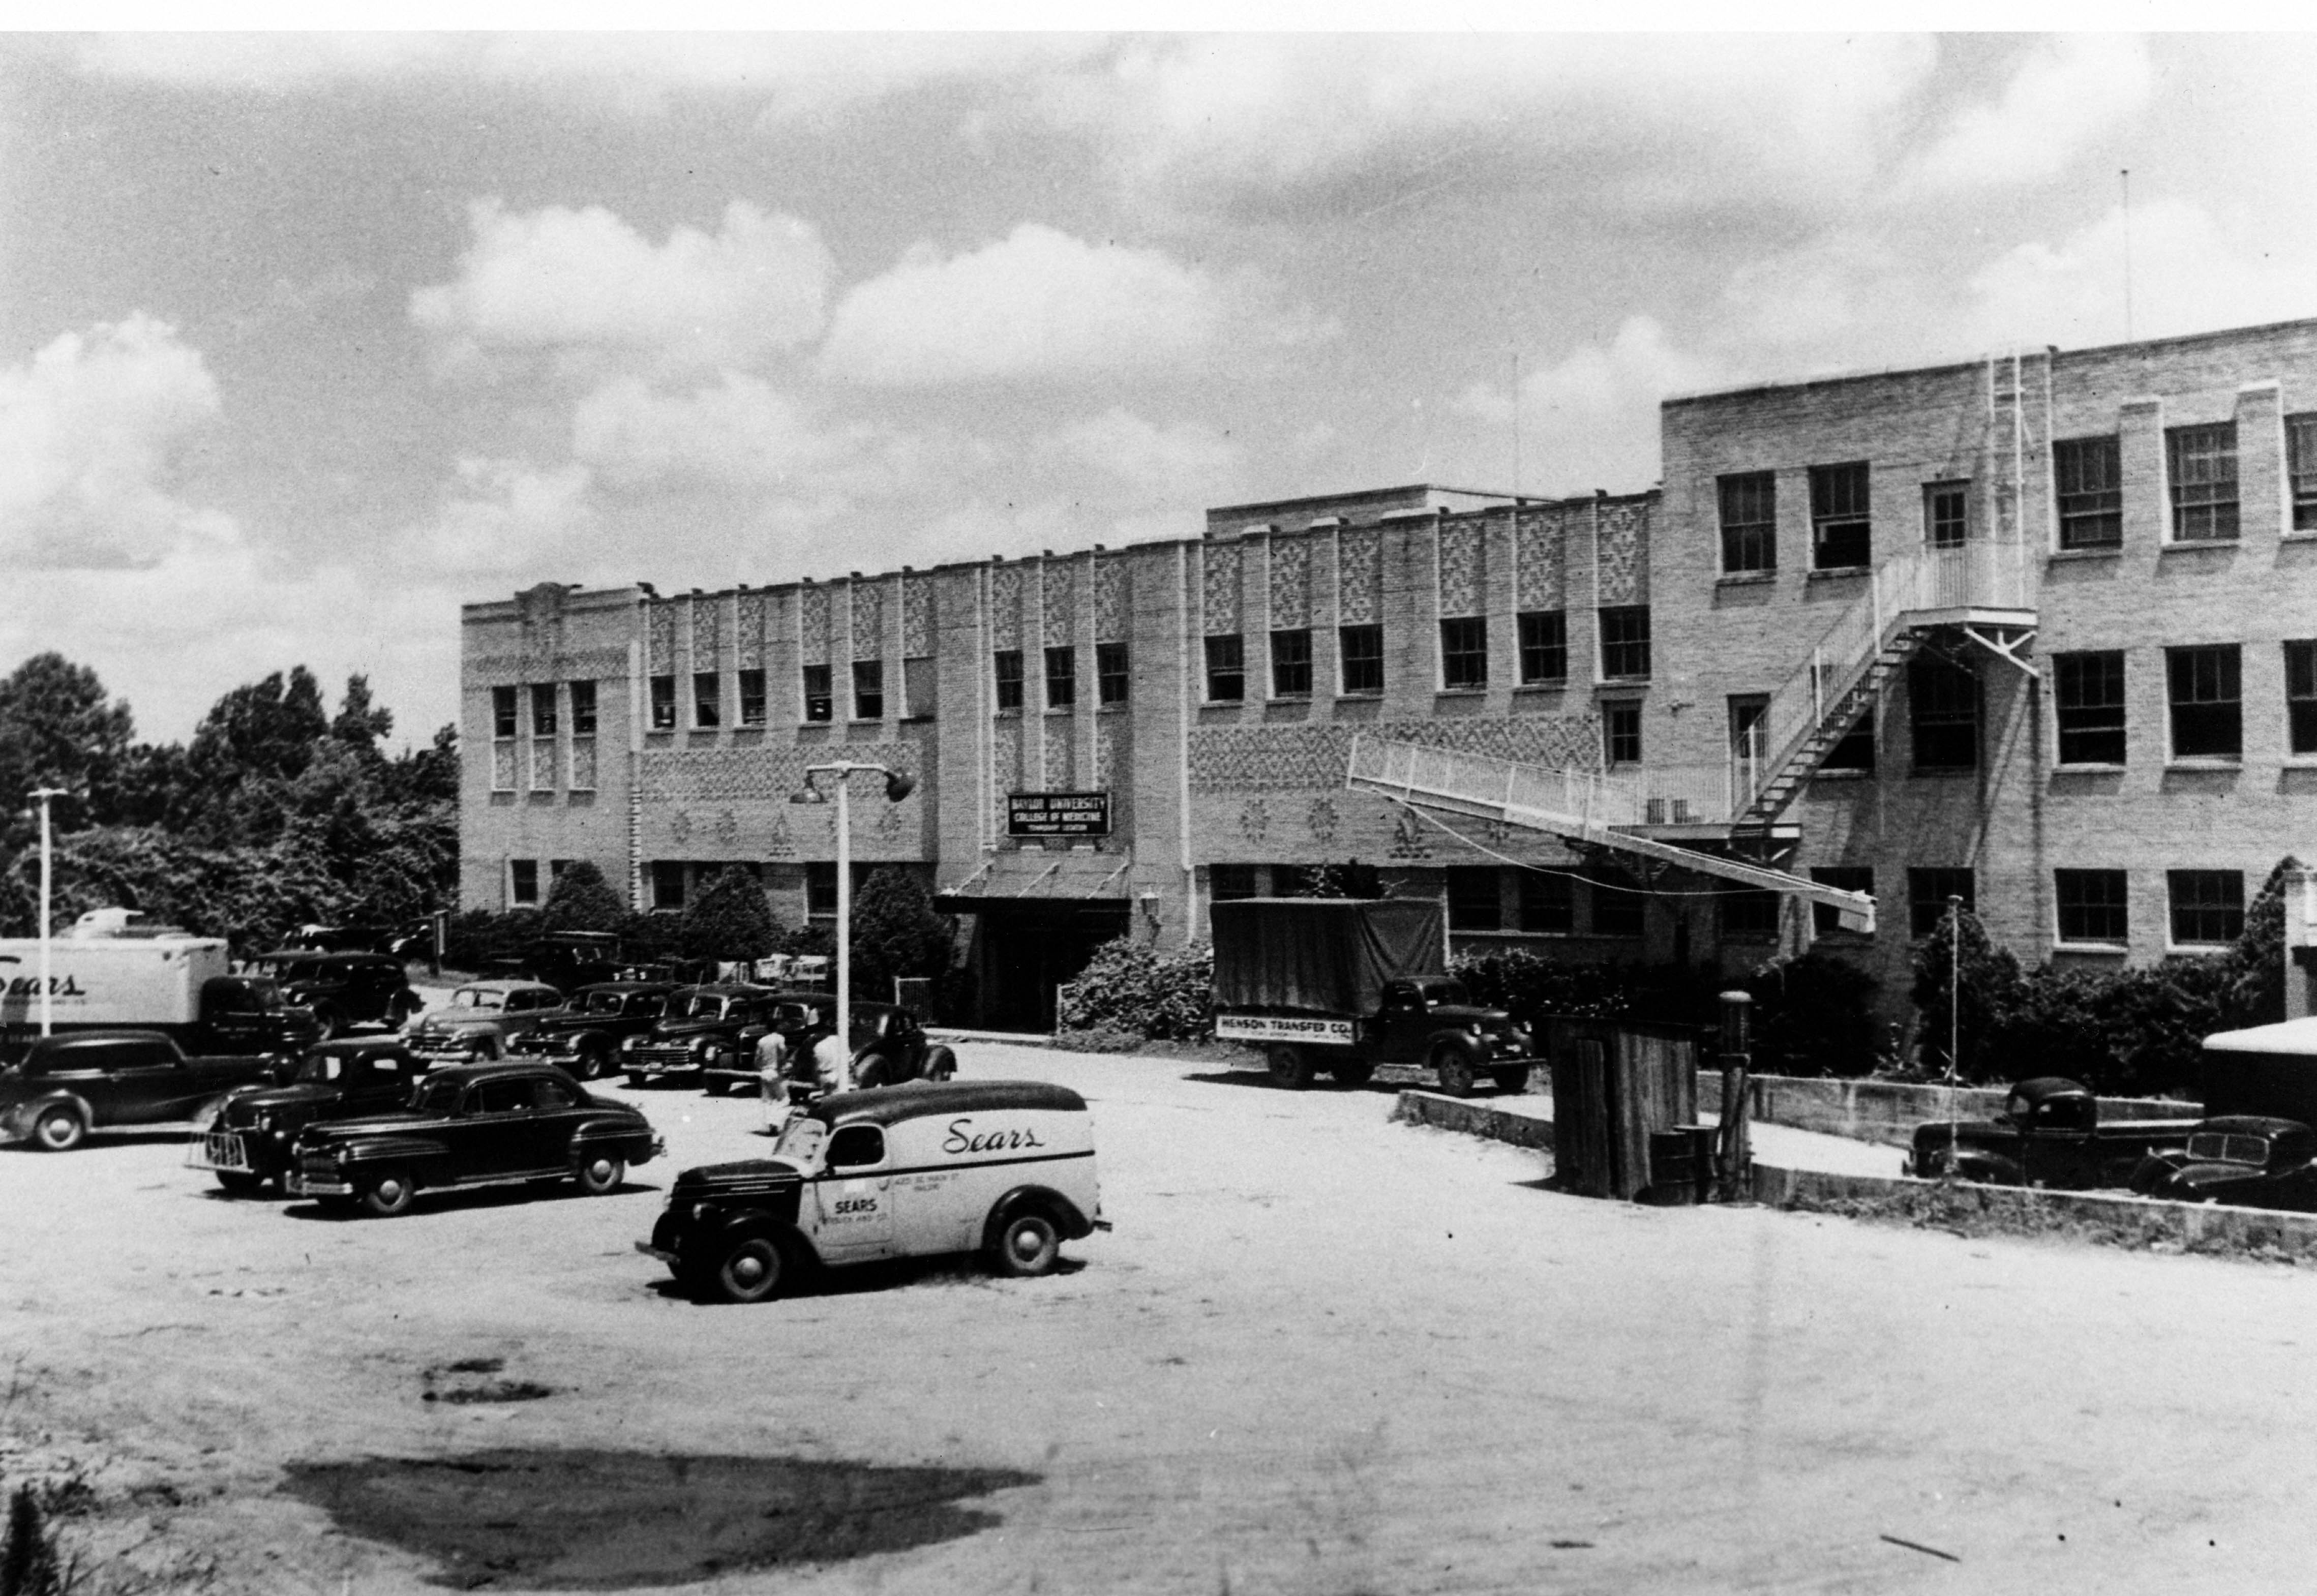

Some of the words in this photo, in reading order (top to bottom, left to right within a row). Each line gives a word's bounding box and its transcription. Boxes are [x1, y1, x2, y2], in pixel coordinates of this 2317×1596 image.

[1049, 797, 1105, 810] UNIVERSITY
[1014, 812, 1047, 822] COLLEGE
[1050, 812, 1060, 822] OF
[1062, 812, 1101, 822] MEDICINE
[1222, 1019, 1266, 1029] HENSON
[1270, 1020, 1326, 1032] TRANSFER
[943, 1119, 1045, 1154] Sears
[835, 1198, 878, 1214] SEARS
